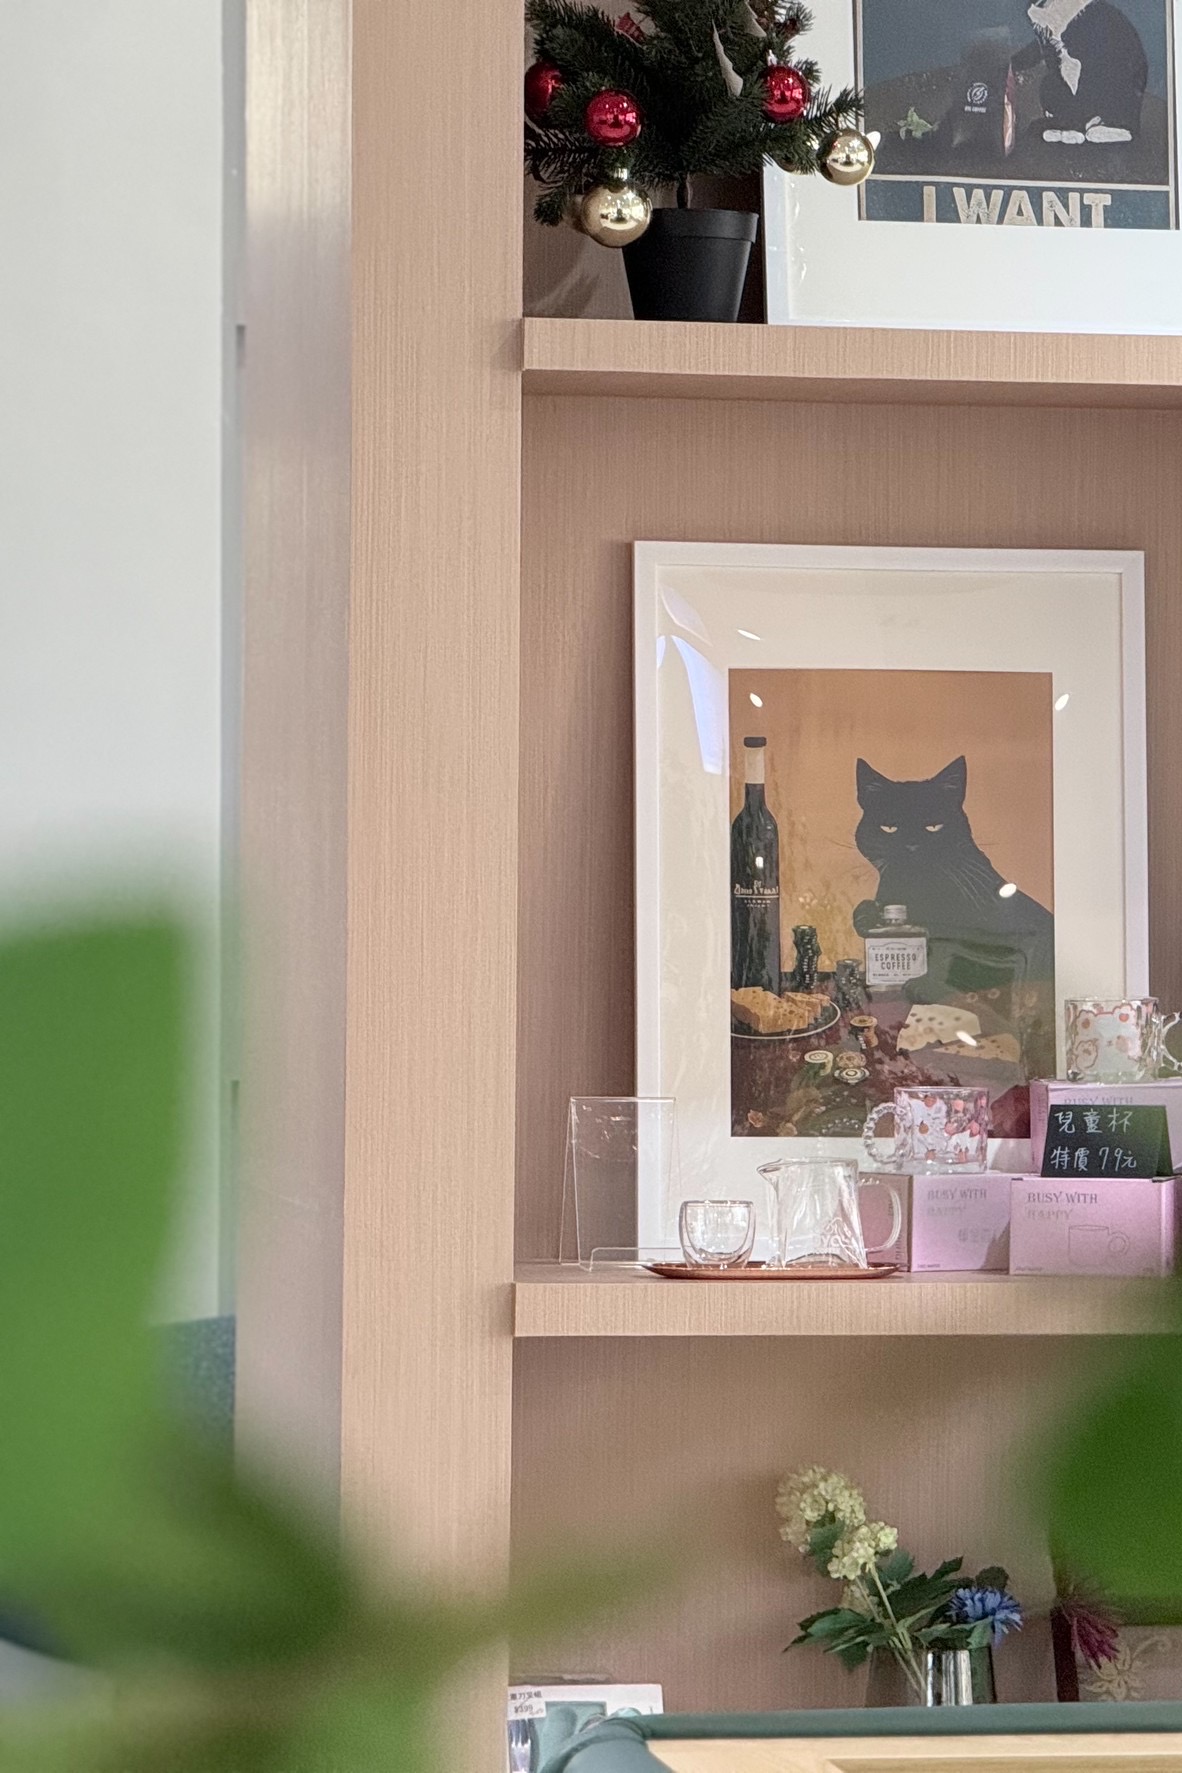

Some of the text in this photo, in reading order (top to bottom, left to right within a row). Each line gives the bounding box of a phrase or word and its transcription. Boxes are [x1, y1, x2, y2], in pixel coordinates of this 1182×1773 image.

[923, 186, 1112, 228] I WANT
[875, 953, 917, 962] ESPRESSO
[880, 961, 911, 970] COFFEE
[1054, 1107, 1134, 1134] 兒童杯
[928, 1188, 987, 1201] BUSY WITH
[1027, 1191, 1098, 1205] BUSY WITH
